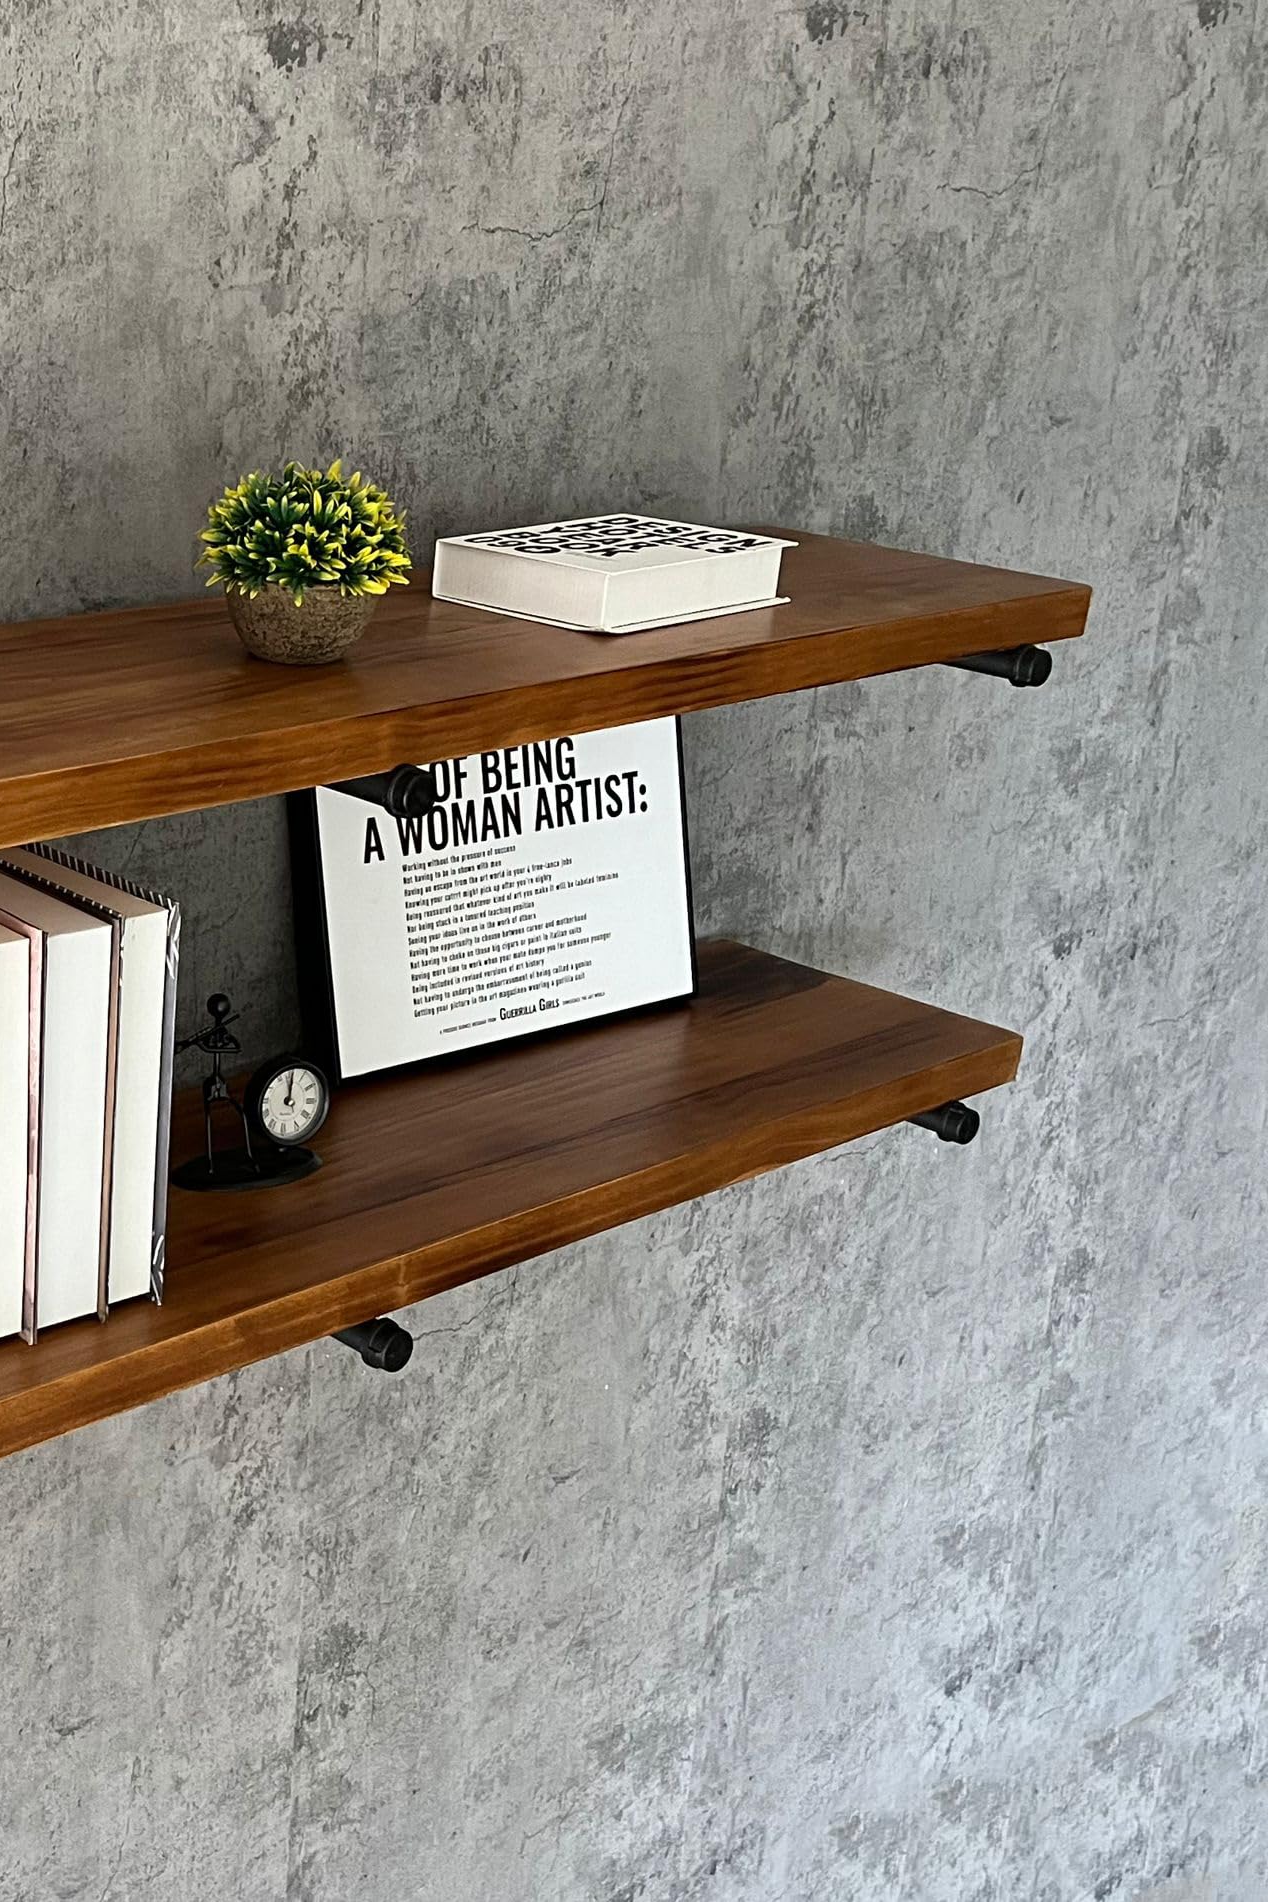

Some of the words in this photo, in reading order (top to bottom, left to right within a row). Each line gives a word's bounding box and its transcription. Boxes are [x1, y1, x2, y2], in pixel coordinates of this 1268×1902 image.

[498, 532, 639, 557] BOOK
[540, 526, 659, 549] YEAR
[566, 522, 746, 553] HOTELS
[599, 517, 773, 547] DESIGN
[430, 756, 468, 803] OF
[481, 736, 577, 794] BEING
[363, 817, 385, 864] A
[397, 791, 522, 857] WOMAN
[534, 771, 649, 832] ARTIST:
